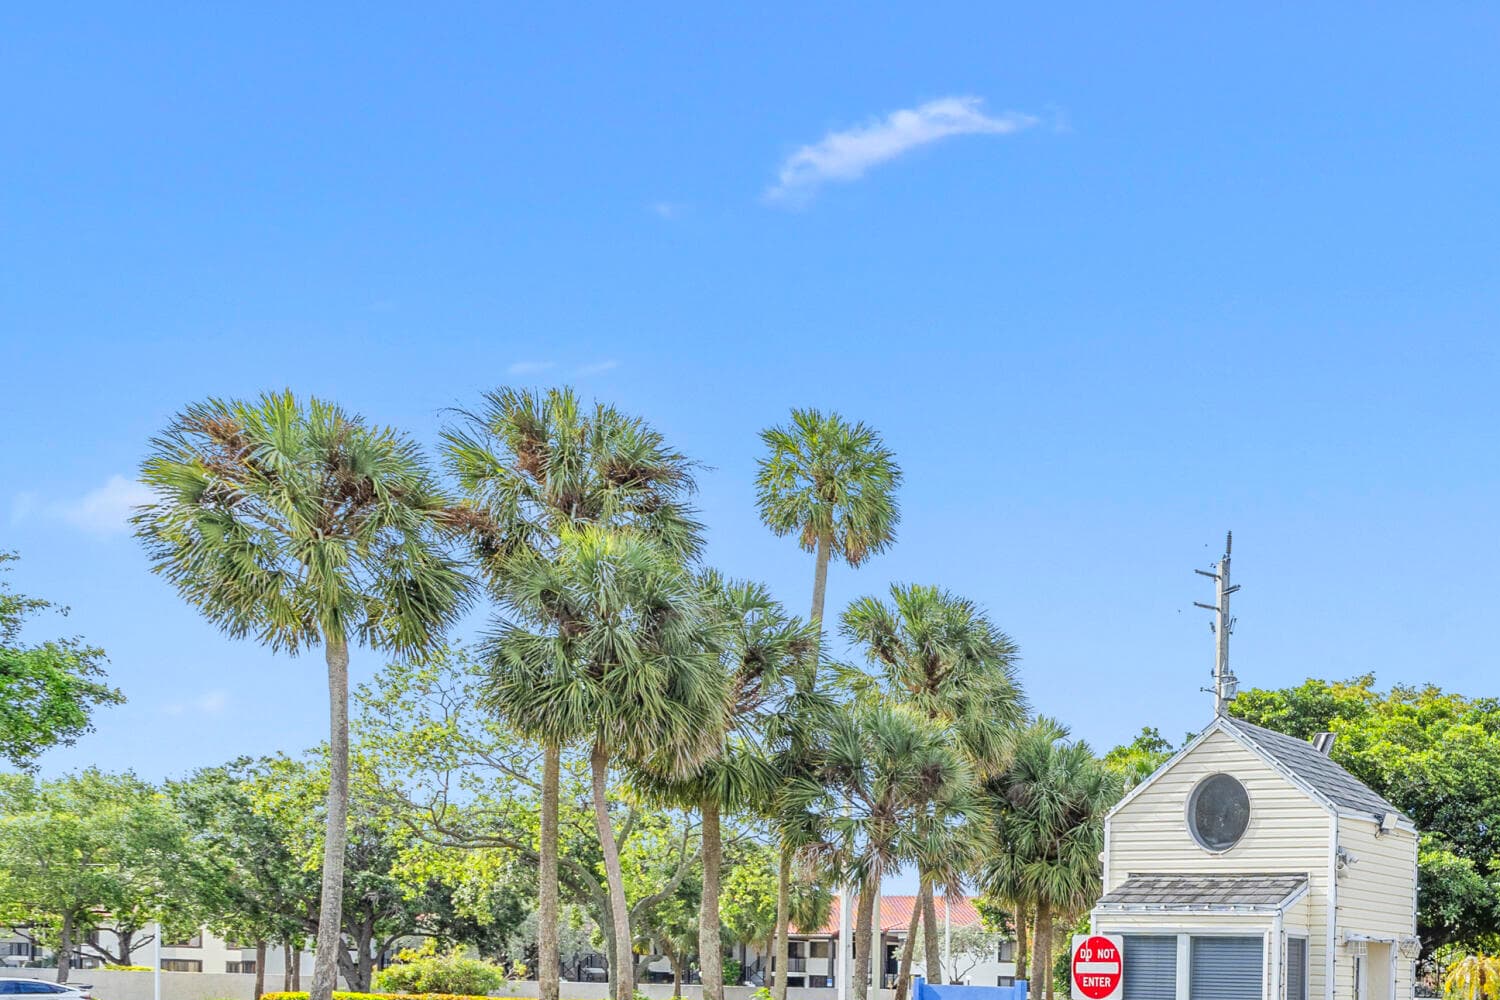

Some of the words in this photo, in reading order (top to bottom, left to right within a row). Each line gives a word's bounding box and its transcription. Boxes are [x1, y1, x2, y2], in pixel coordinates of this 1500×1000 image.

[1080, 948, 1092, 959] DO
[1097, 949, 1115, 960] NOT
[1083, 976, 1111, 988] ENTER
